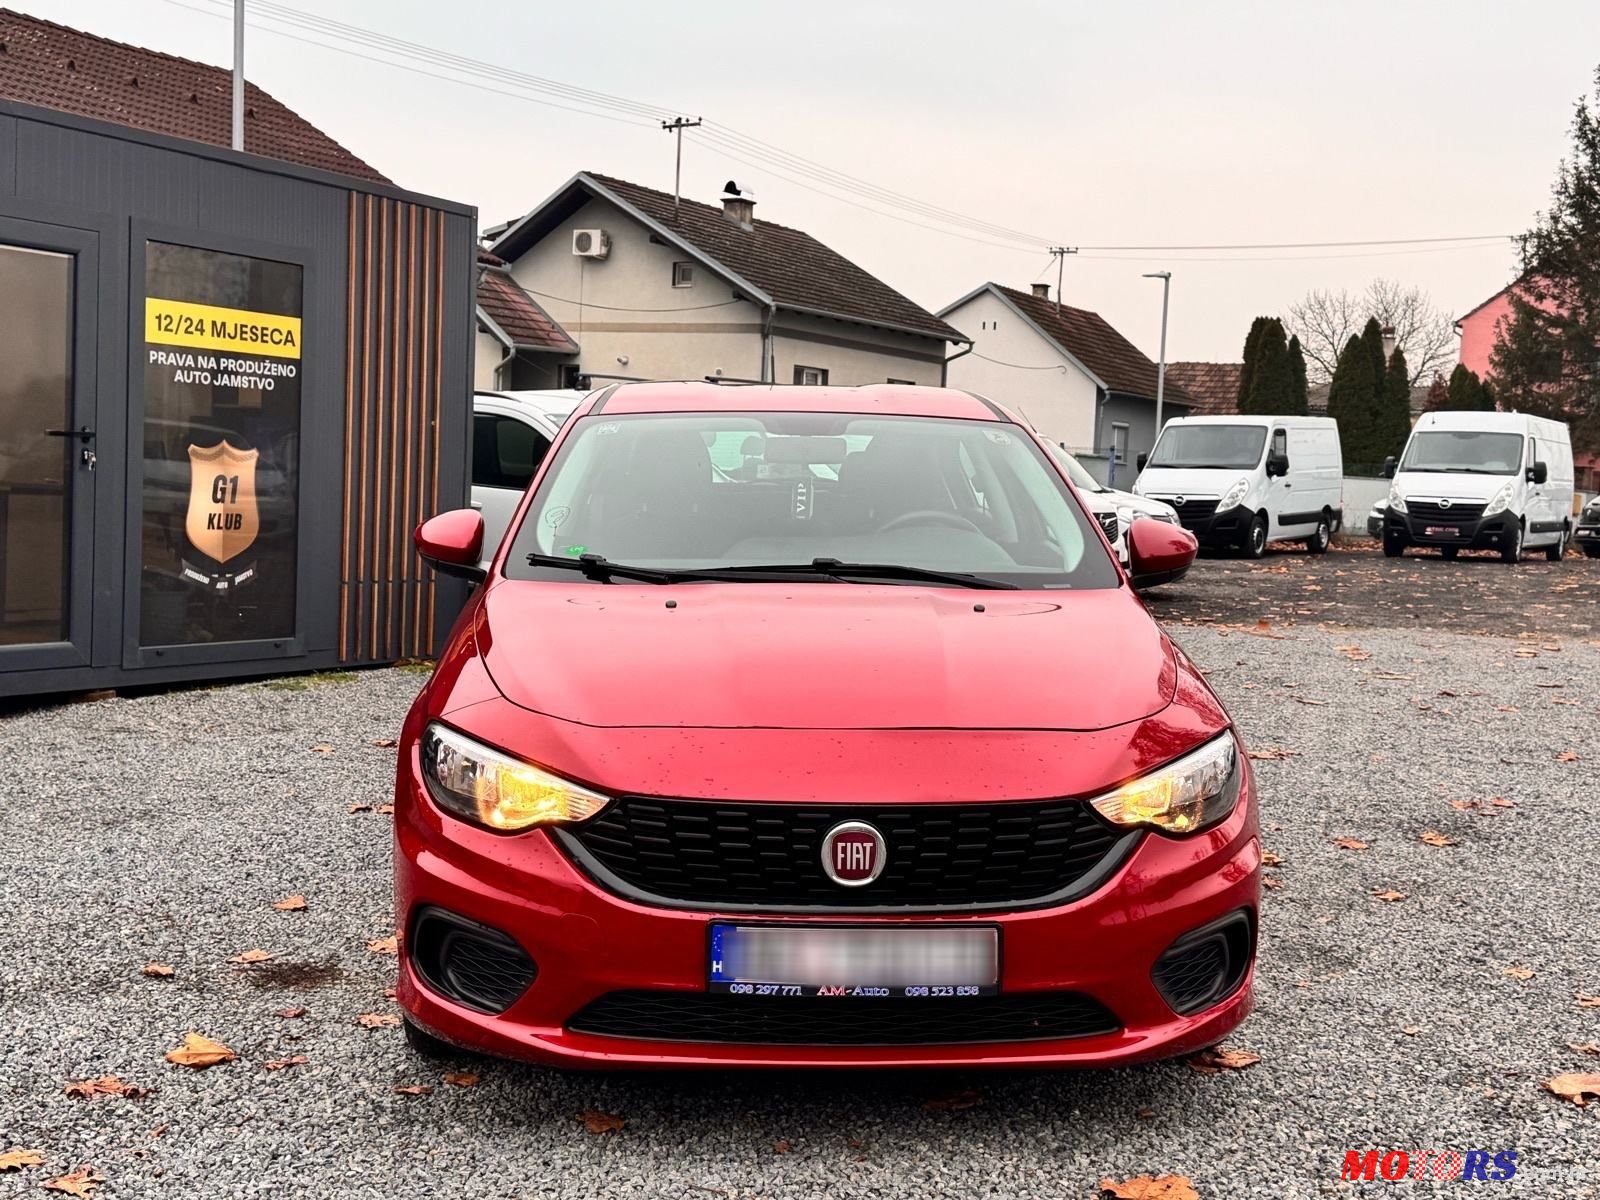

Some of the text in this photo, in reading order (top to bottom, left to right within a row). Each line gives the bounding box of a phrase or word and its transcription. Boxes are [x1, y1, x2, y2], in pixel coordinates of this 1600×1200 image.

[155, 313, 296, 347] 12/24 MJESECA
[149, 350, 296, 378] PRAVA NA PRODUŽENO
[174, 369, 275, 391] AUTO JAMSTVO
[211, 474, 239, 504] G1
[207, 512, 243, 531] KLUB
[836, 842, 874, 870] FIAT
[712, 960, 723, 974] H
[729, 984, 754, 995] 098
[755, 985, 779, 996] 297
[781, 985, 803, 997] 771
[816, 985, 890, 997] AM-Auto
[930, 986, 954, 998] 523
